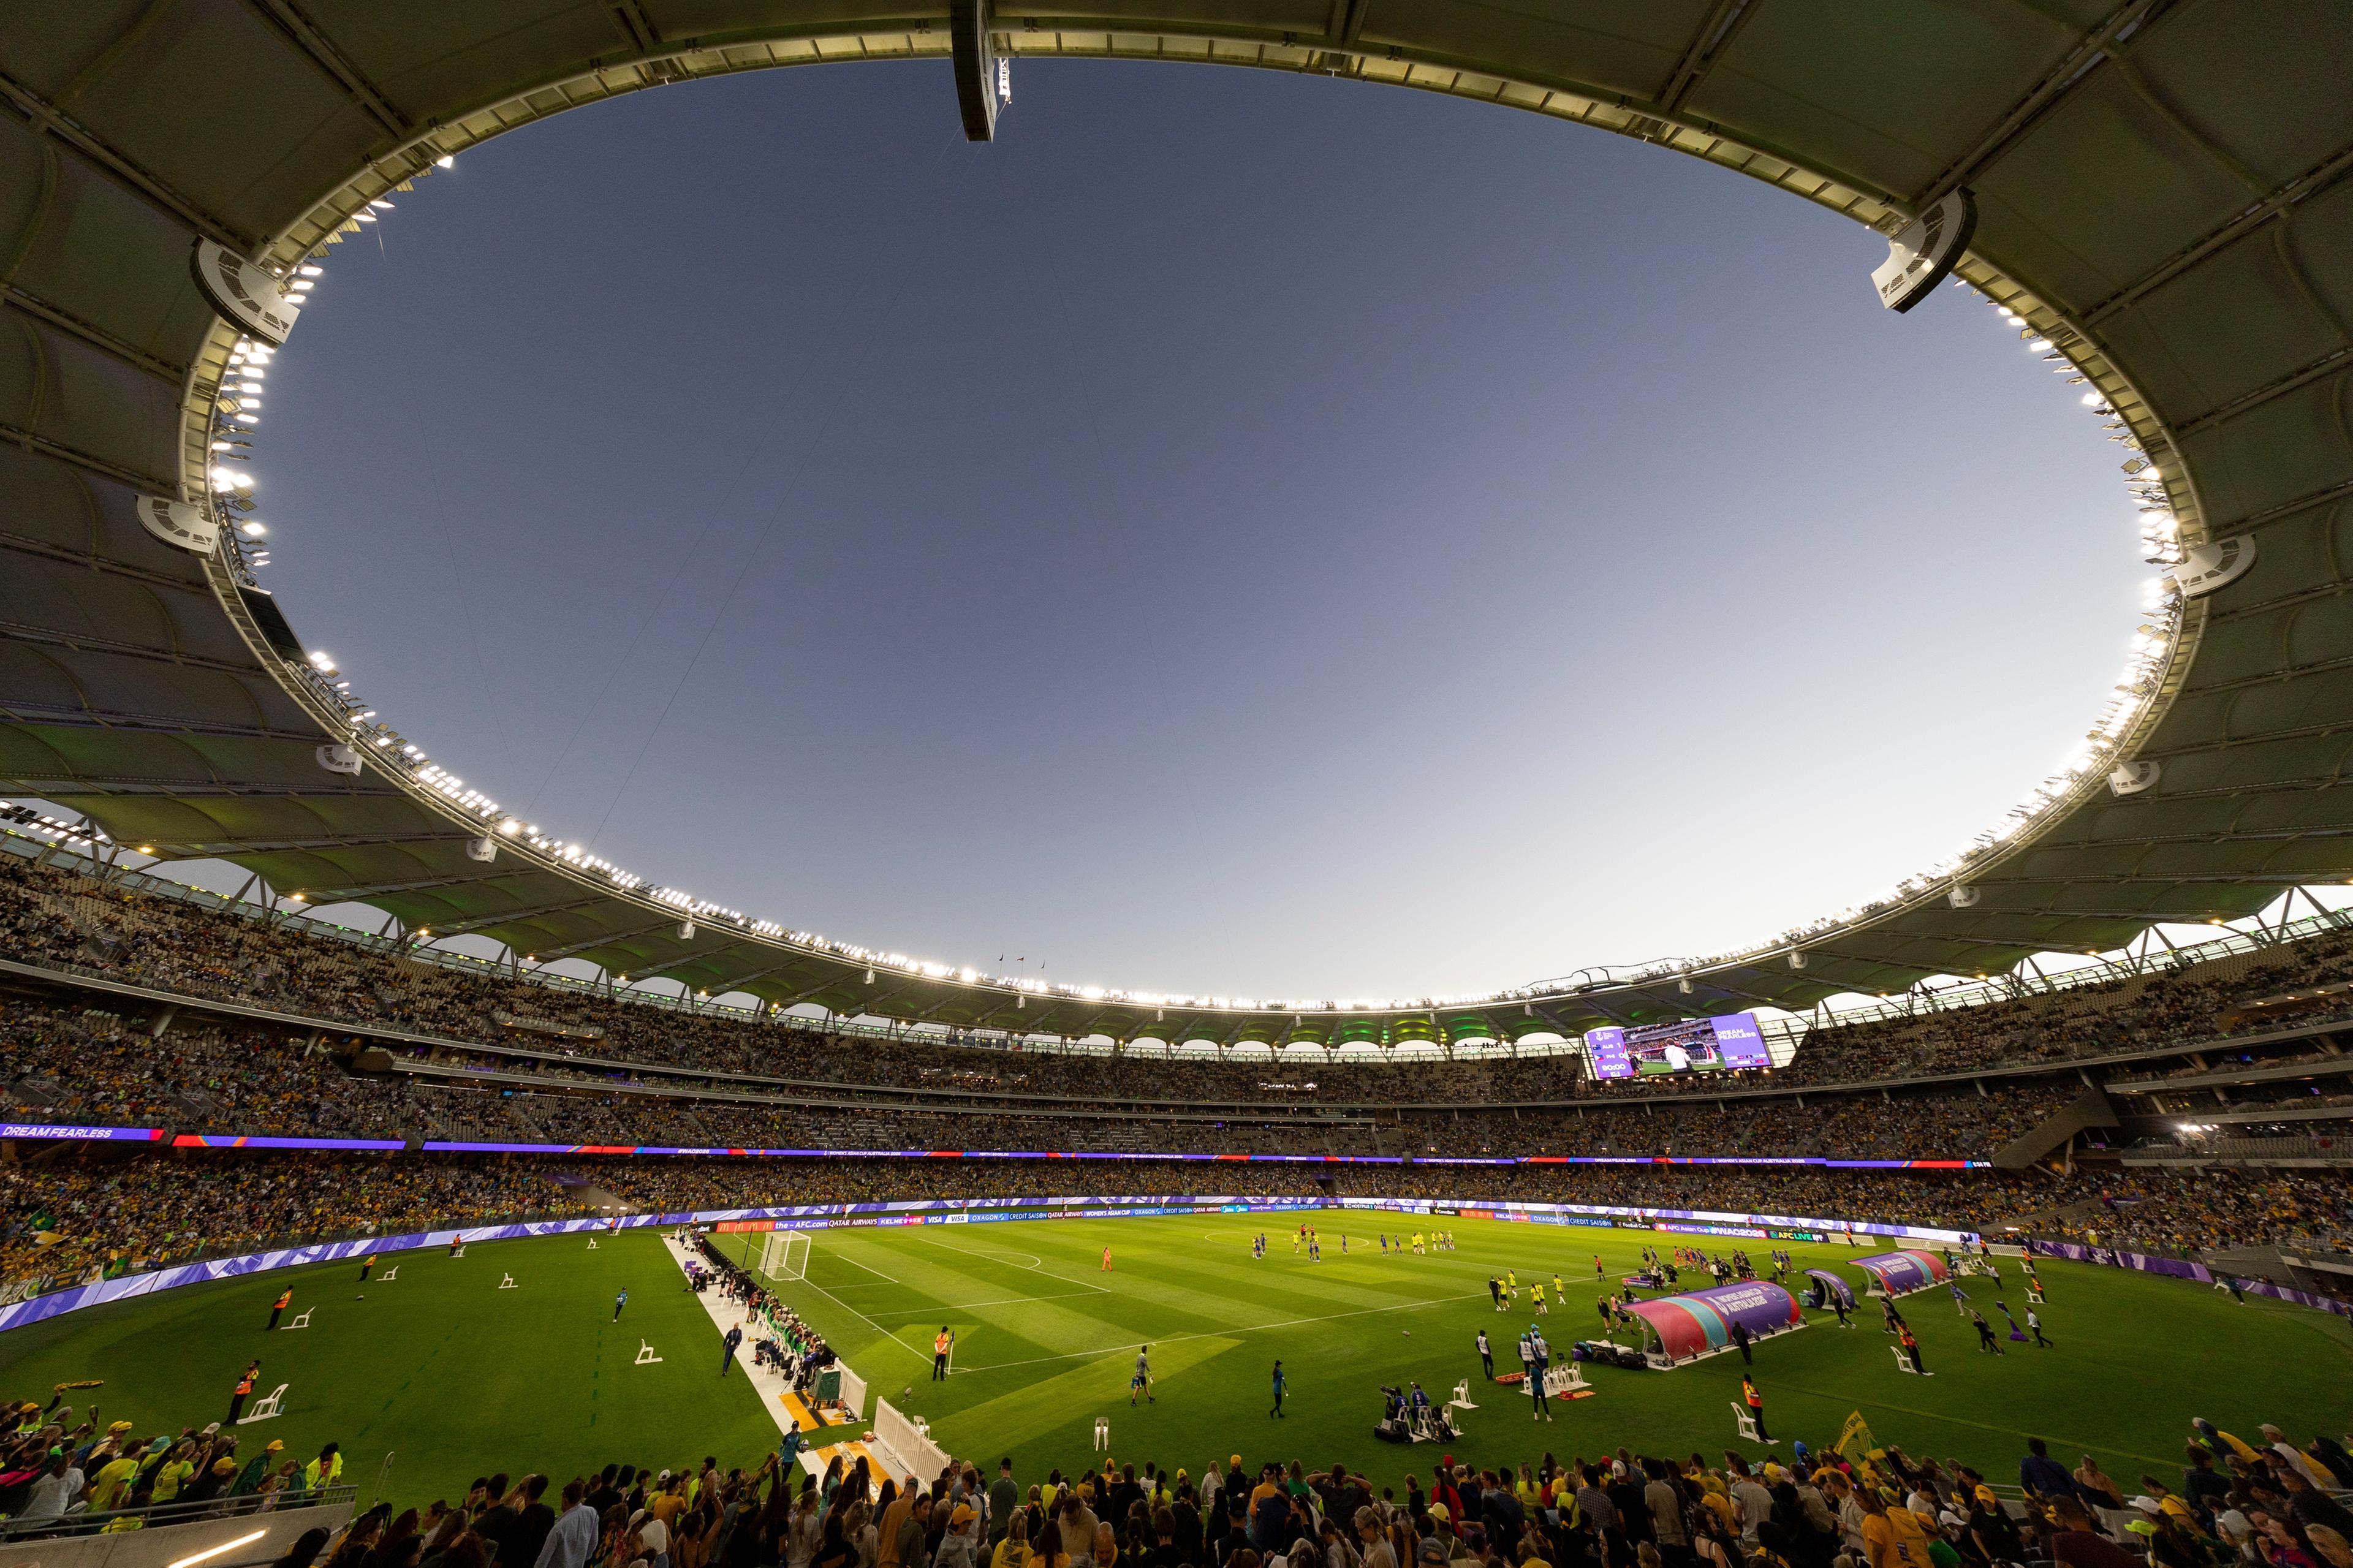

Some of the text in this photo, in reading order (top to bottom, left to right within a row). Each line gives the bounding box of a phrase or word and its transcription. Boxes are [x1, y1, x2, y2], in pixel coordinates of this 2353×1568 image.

[2, 1126, 113, 1138] DREAM FEARLESS
[795, 1221, 827, 1229] AFC.com
[1710, 1227, 1766, 1238] #WAC2026
[1726, 1297, 1757, 1312] AUSTRALIA
